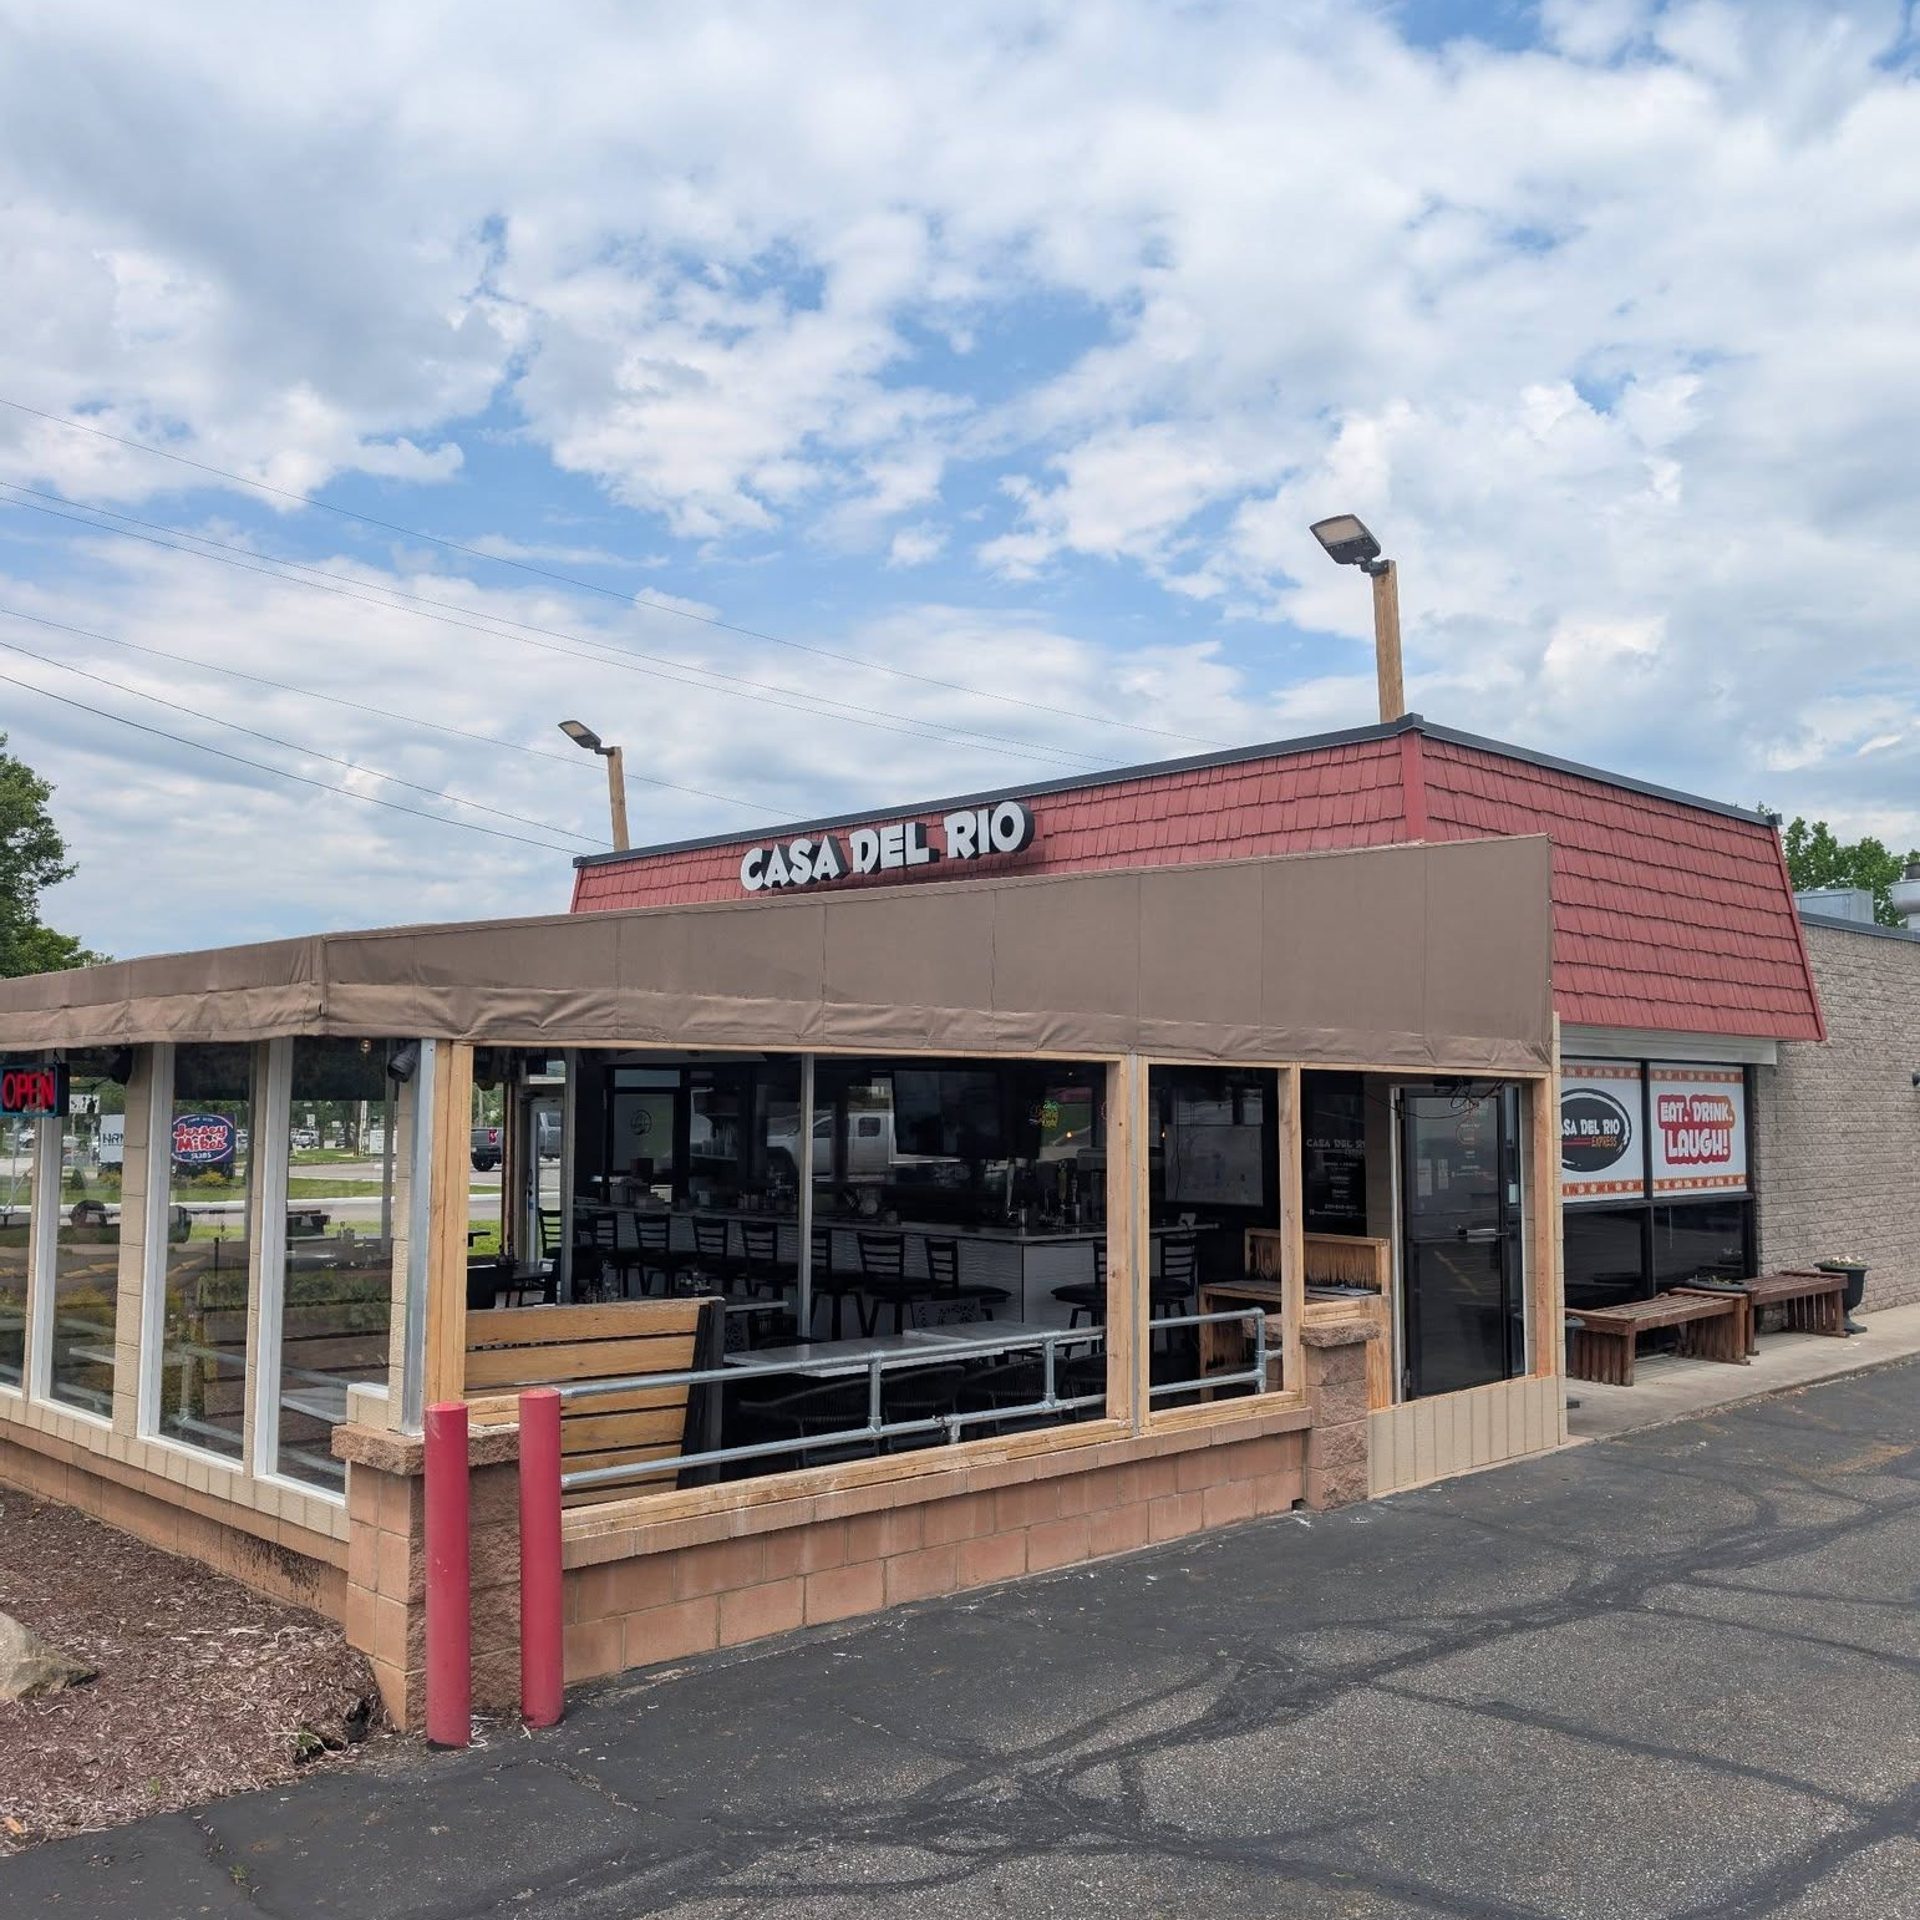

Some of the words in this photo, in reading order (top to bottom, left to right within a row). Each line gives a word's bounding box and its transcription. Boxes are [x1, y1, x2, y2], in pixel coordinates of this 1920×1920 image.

[740, 835, 843, 891] CASA
[850, 822, 932, 874] DEL
[944, 801, 1027, 860] RIO
[2, 1071, 55, 1111] OPEN
[1660, 1101, 1689, 1122] EAT.
[1691, 1101, 1733, 1122] DRINK.
[173, 1124, 228, 1141] Jersey
[1580, 1118, 1600, 1135] DEL
[1602, 1118, 1620, 1135] RIO
[1591, 1135, 1618, 1148] EXPRESS
[1667, 1128, 1729, 1158] LAUGH!
